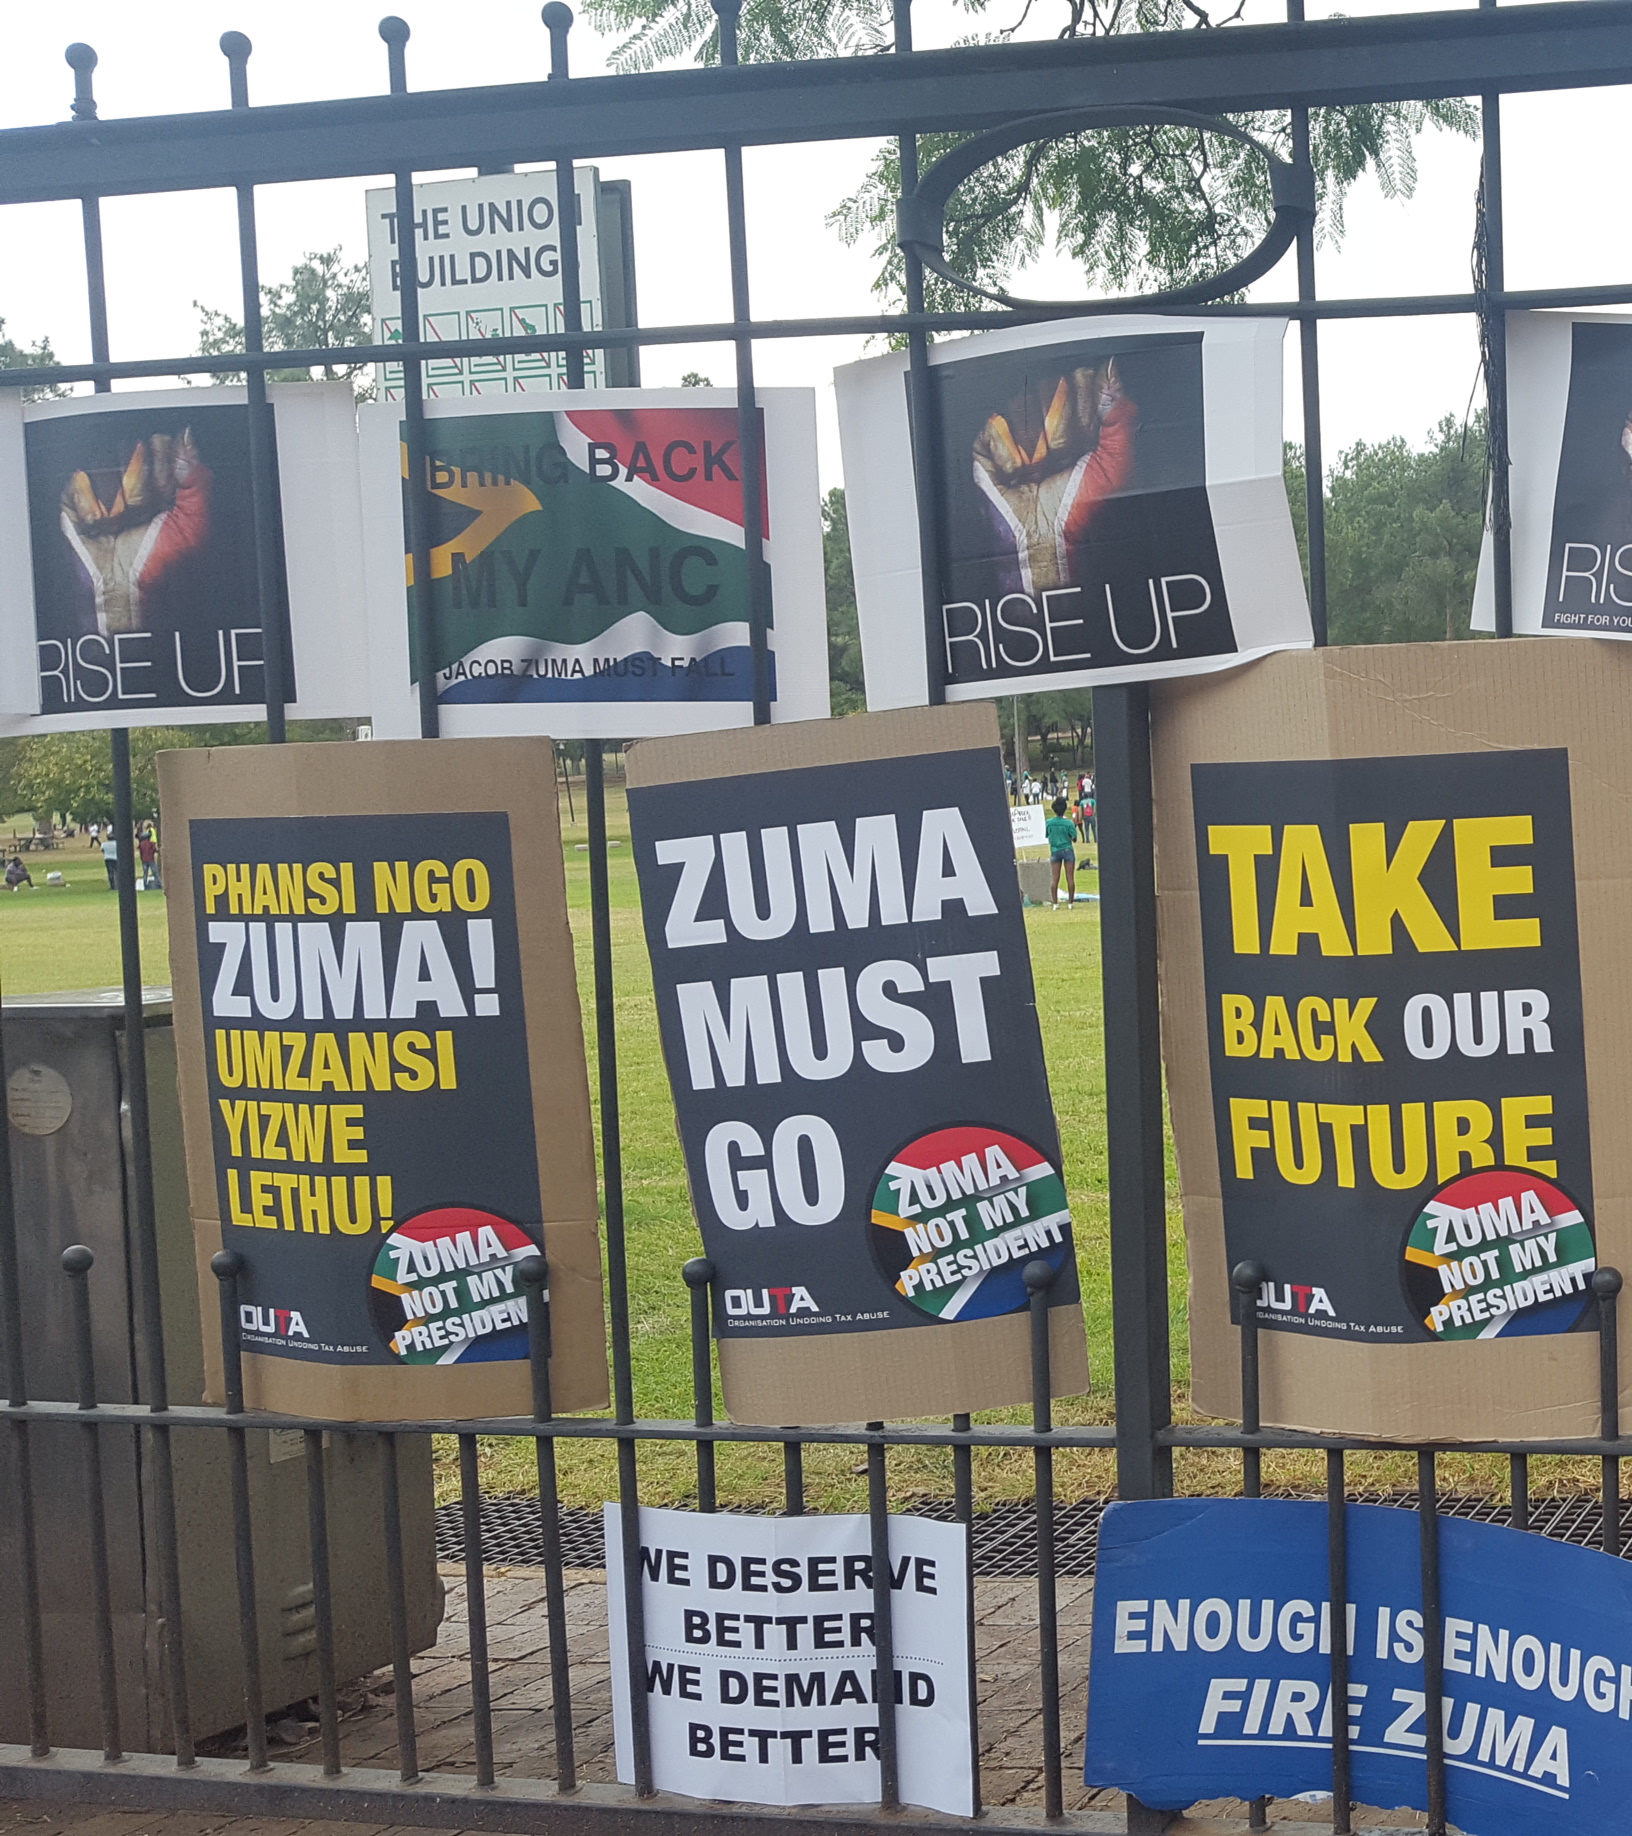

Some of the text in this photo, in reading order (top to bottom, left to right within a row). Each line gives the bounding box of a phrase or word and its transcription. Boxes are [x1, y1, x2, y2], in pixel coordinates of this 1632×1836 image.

[431, 440, 739, 490] BRING BACK
[450, 545, 720, 609] MY ANC
[942, 573, 1211, 673] RISE UP
[1554, 612, 1586, 625] FIGHT
[1587, 614, 1610, 626] FOR
[37, 632, 157, 703] RISE
[443, 656, 735, 681] JACOB ZUMA MUST FALL
[203, 858, 490, 915] PHANSI NGO
[655, 806, 999, 949] ZUMA
[1207, 815, 1541, 957] TAKE
[208, 918, 500, 1020] ZUMA!
[676, 951, 1000, 1090] MUST
[1221, 989, 1554, 1063] BACK OUR
[215, 1029, 457, 1092] UMZANSI
[218, 1099, 368, 1163] YIZWE
[1229, 1095, 1558, 1190] FUTURE
[227, 1168, 394, 1235] LETHU!
[704, 1114, 845, 1231] GO
[888, 1144, 1020, 1219] ZUMA
[904, 1186, 1030, 1257] NOT MY
[1426, 1190, 1551, 1256] ZUMA
[388, 1225, 509, 1284] ZUMA
[900, 1219, 1063, 1298] PRESIDENT
[1437, 1232, 1557, 1293] NOT MY
[240, 1304, 310, 1338] OUTA
[394, 1288, 549, 1355] PRESIDEN
[400, 1265, 515, 1320] NOT MY
[724, 1286, 820, 1315] OUTA
[1257, 1312, 1305, 1324] GANISATION
[1430, 1265, 1586, 1333] PRESIDENT
[640, 1546, 937, 1596] WE DESERVE
[684, 1608, 876, 1651] BETTER
[1114, 1598, 1355, 1655] ENOUGH
[1376, 1606, 1424, 1663] IS
[646, 1660, 702, 1701] WE
[688, 1722, 881, 1764] BETTER
[1198, 1678, 1570, 1788] FIRE ZUMA
